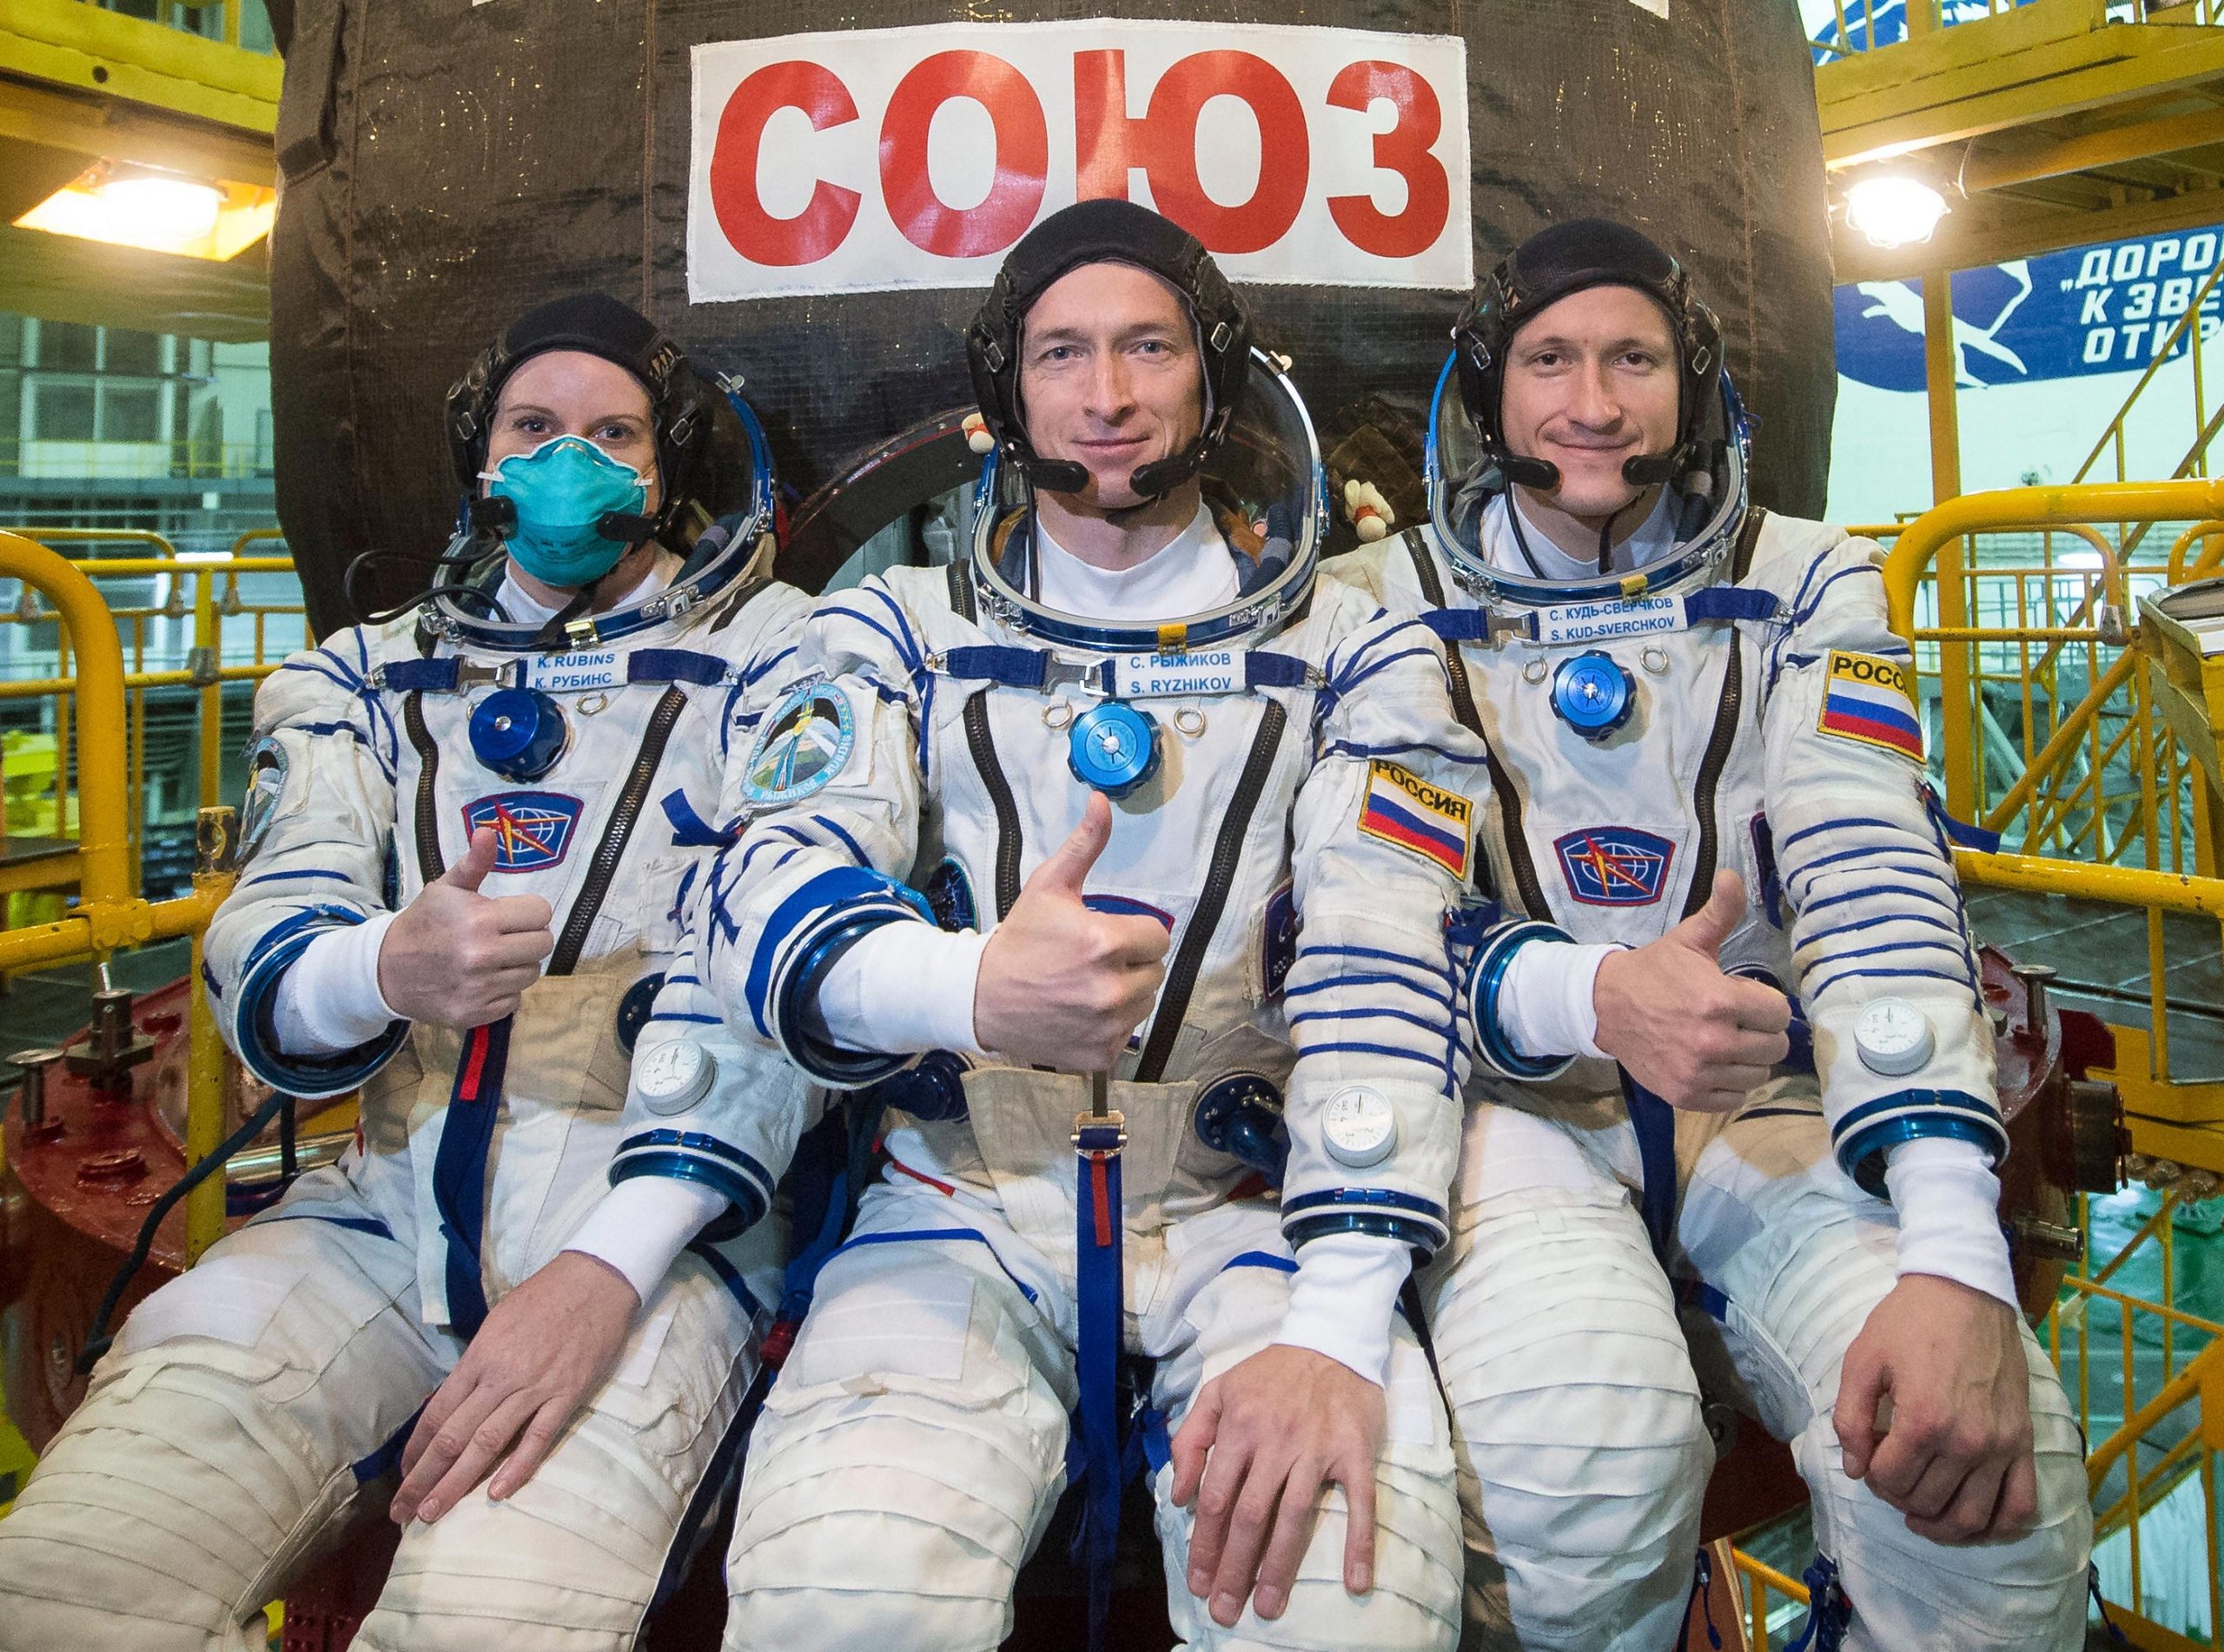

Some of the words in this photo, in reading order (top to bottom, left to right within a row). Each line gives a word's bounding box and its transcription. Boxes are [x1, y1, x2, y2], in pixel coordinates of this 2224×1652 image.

[711, 49, 1450, 267] СОЮЗ
[2060, 231, 2224, 291] „ДОРО
[2080, 287, 2114, 326] К
[1550, 610, 1563, 621] С.
[1565, 597, 1674, 619] КУДЬ-СВЕРЧКОВ
[1552, 630, 1563, 641] S.
[1566, 616, 1676, 640] KUD-SVERCHKOV
[537, 657, 551, 668] K.
[554, 653, 615, 667] RUBINS
[1130, 657, 1145, 669] С.
[1150, 652, 1231, 668] РЫЖИКОВ
[534, 677, 547, 689] К.
[552, 672, 612, 688] РУБИНС
[1131, 681, 1145, 694] S.
[1151, 677, 1232, 693] RYZHIKOV
[1833, 656, 1907, 693] РОСС
[1375, 761, 1466, 821] РОССИЯ
